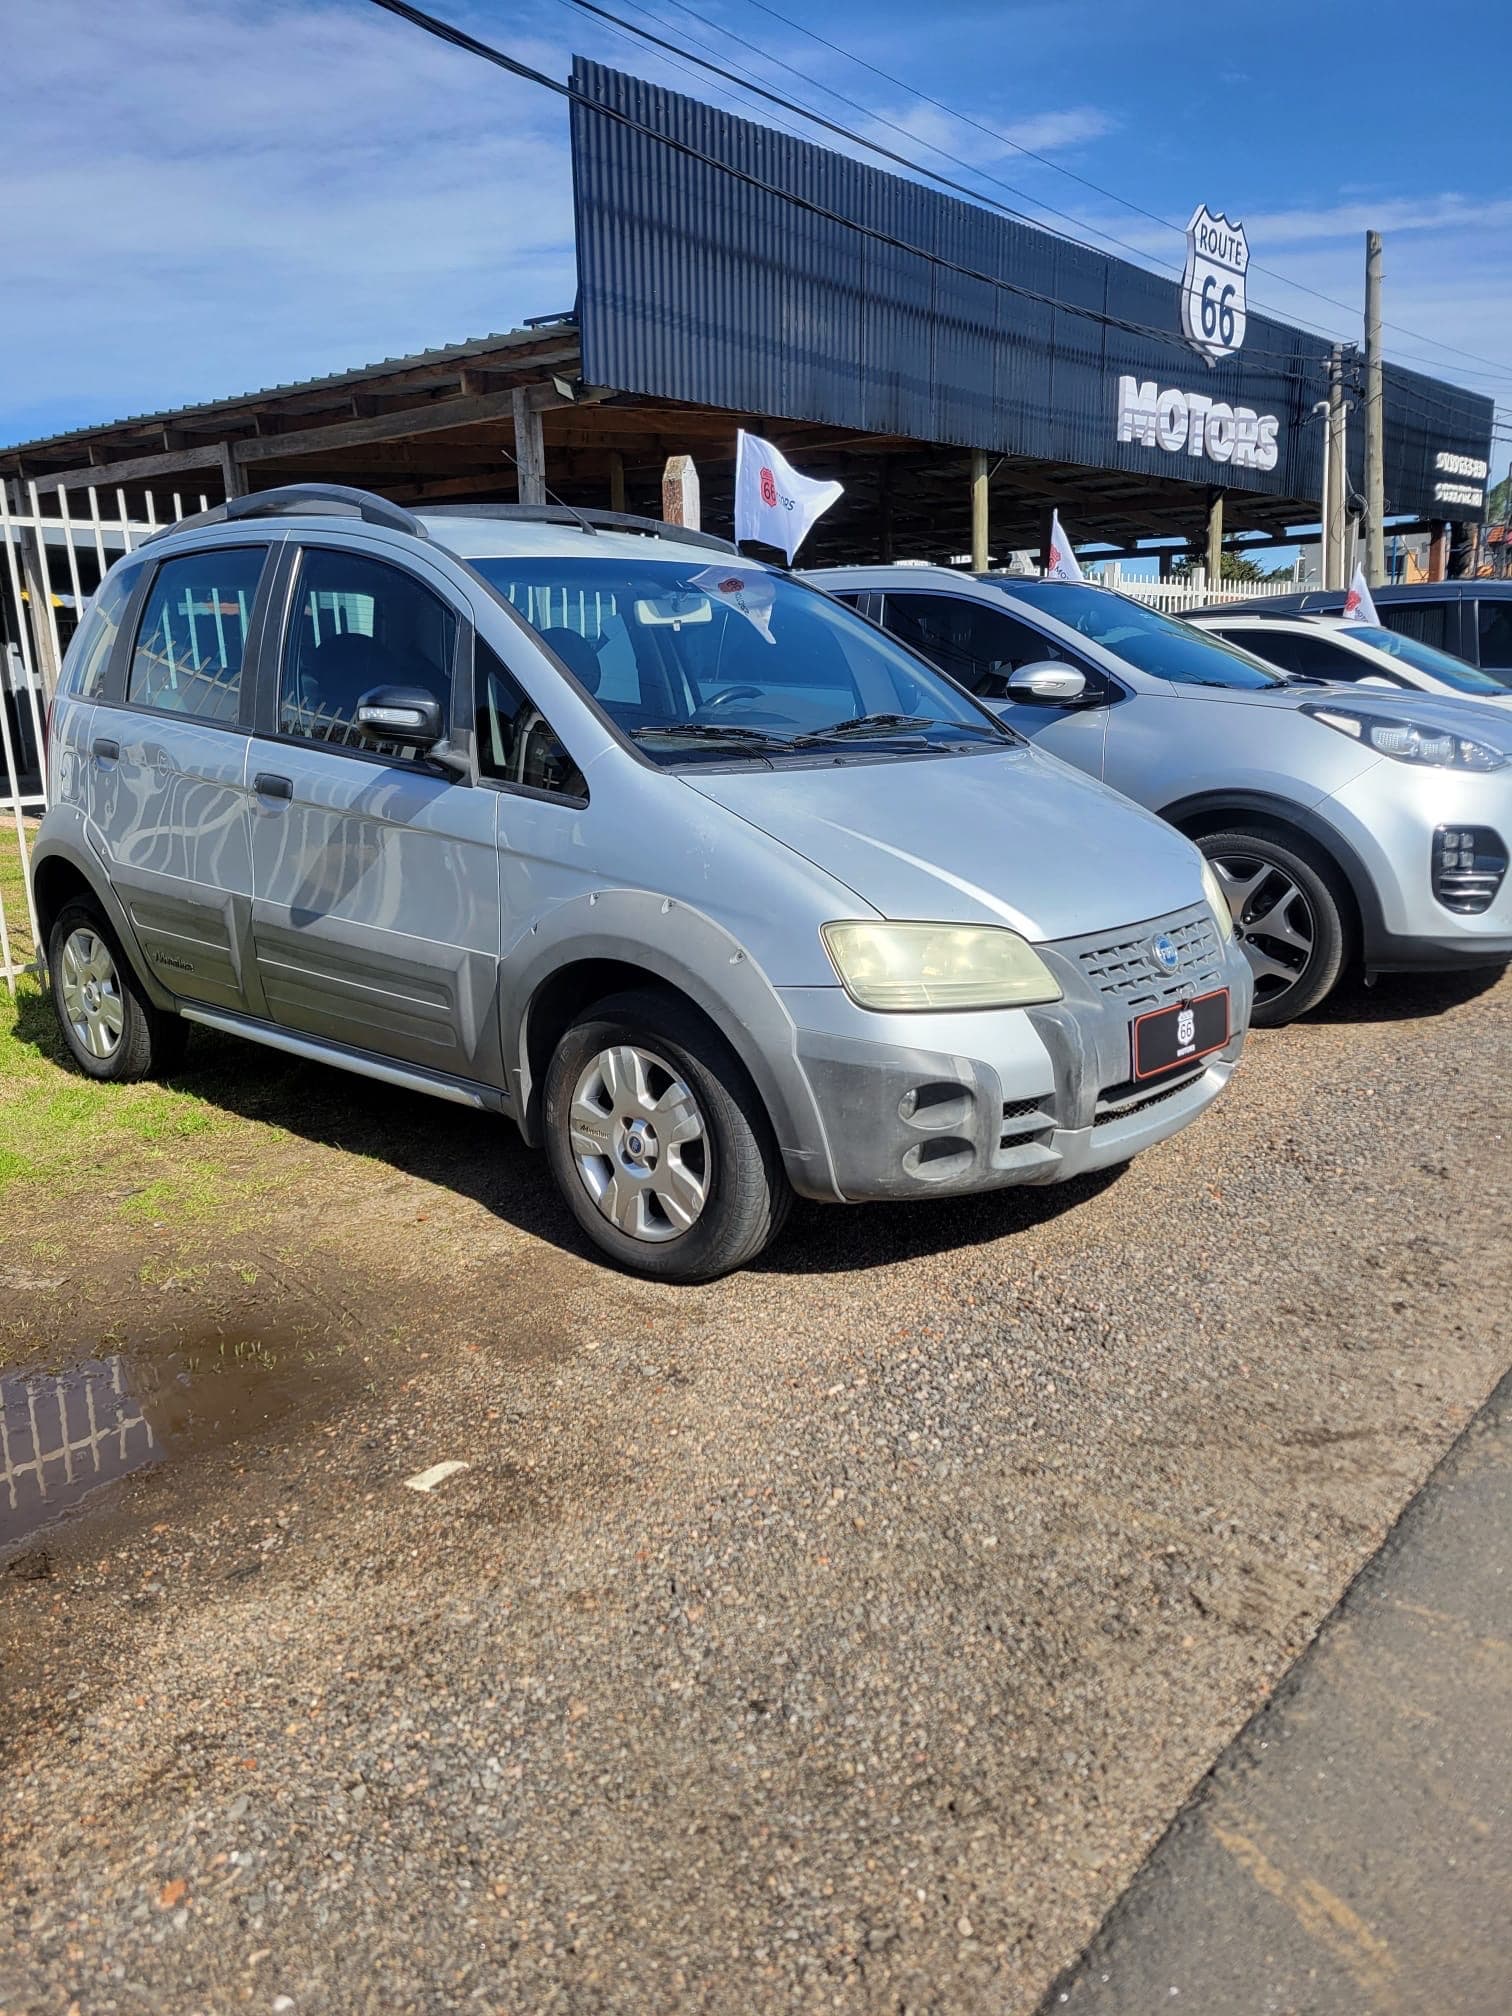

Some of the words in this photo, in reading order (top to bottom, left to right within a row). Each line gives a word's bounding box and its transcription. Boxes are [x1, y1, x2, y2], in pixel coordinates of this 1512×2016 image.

[1200, 223, 1242, 266] ROUTE
[1201, 275, 1236, 346] 66
[1117, 375, 1279, 471] MOTORS
[1181, 1022, 1192, 1039] 66
